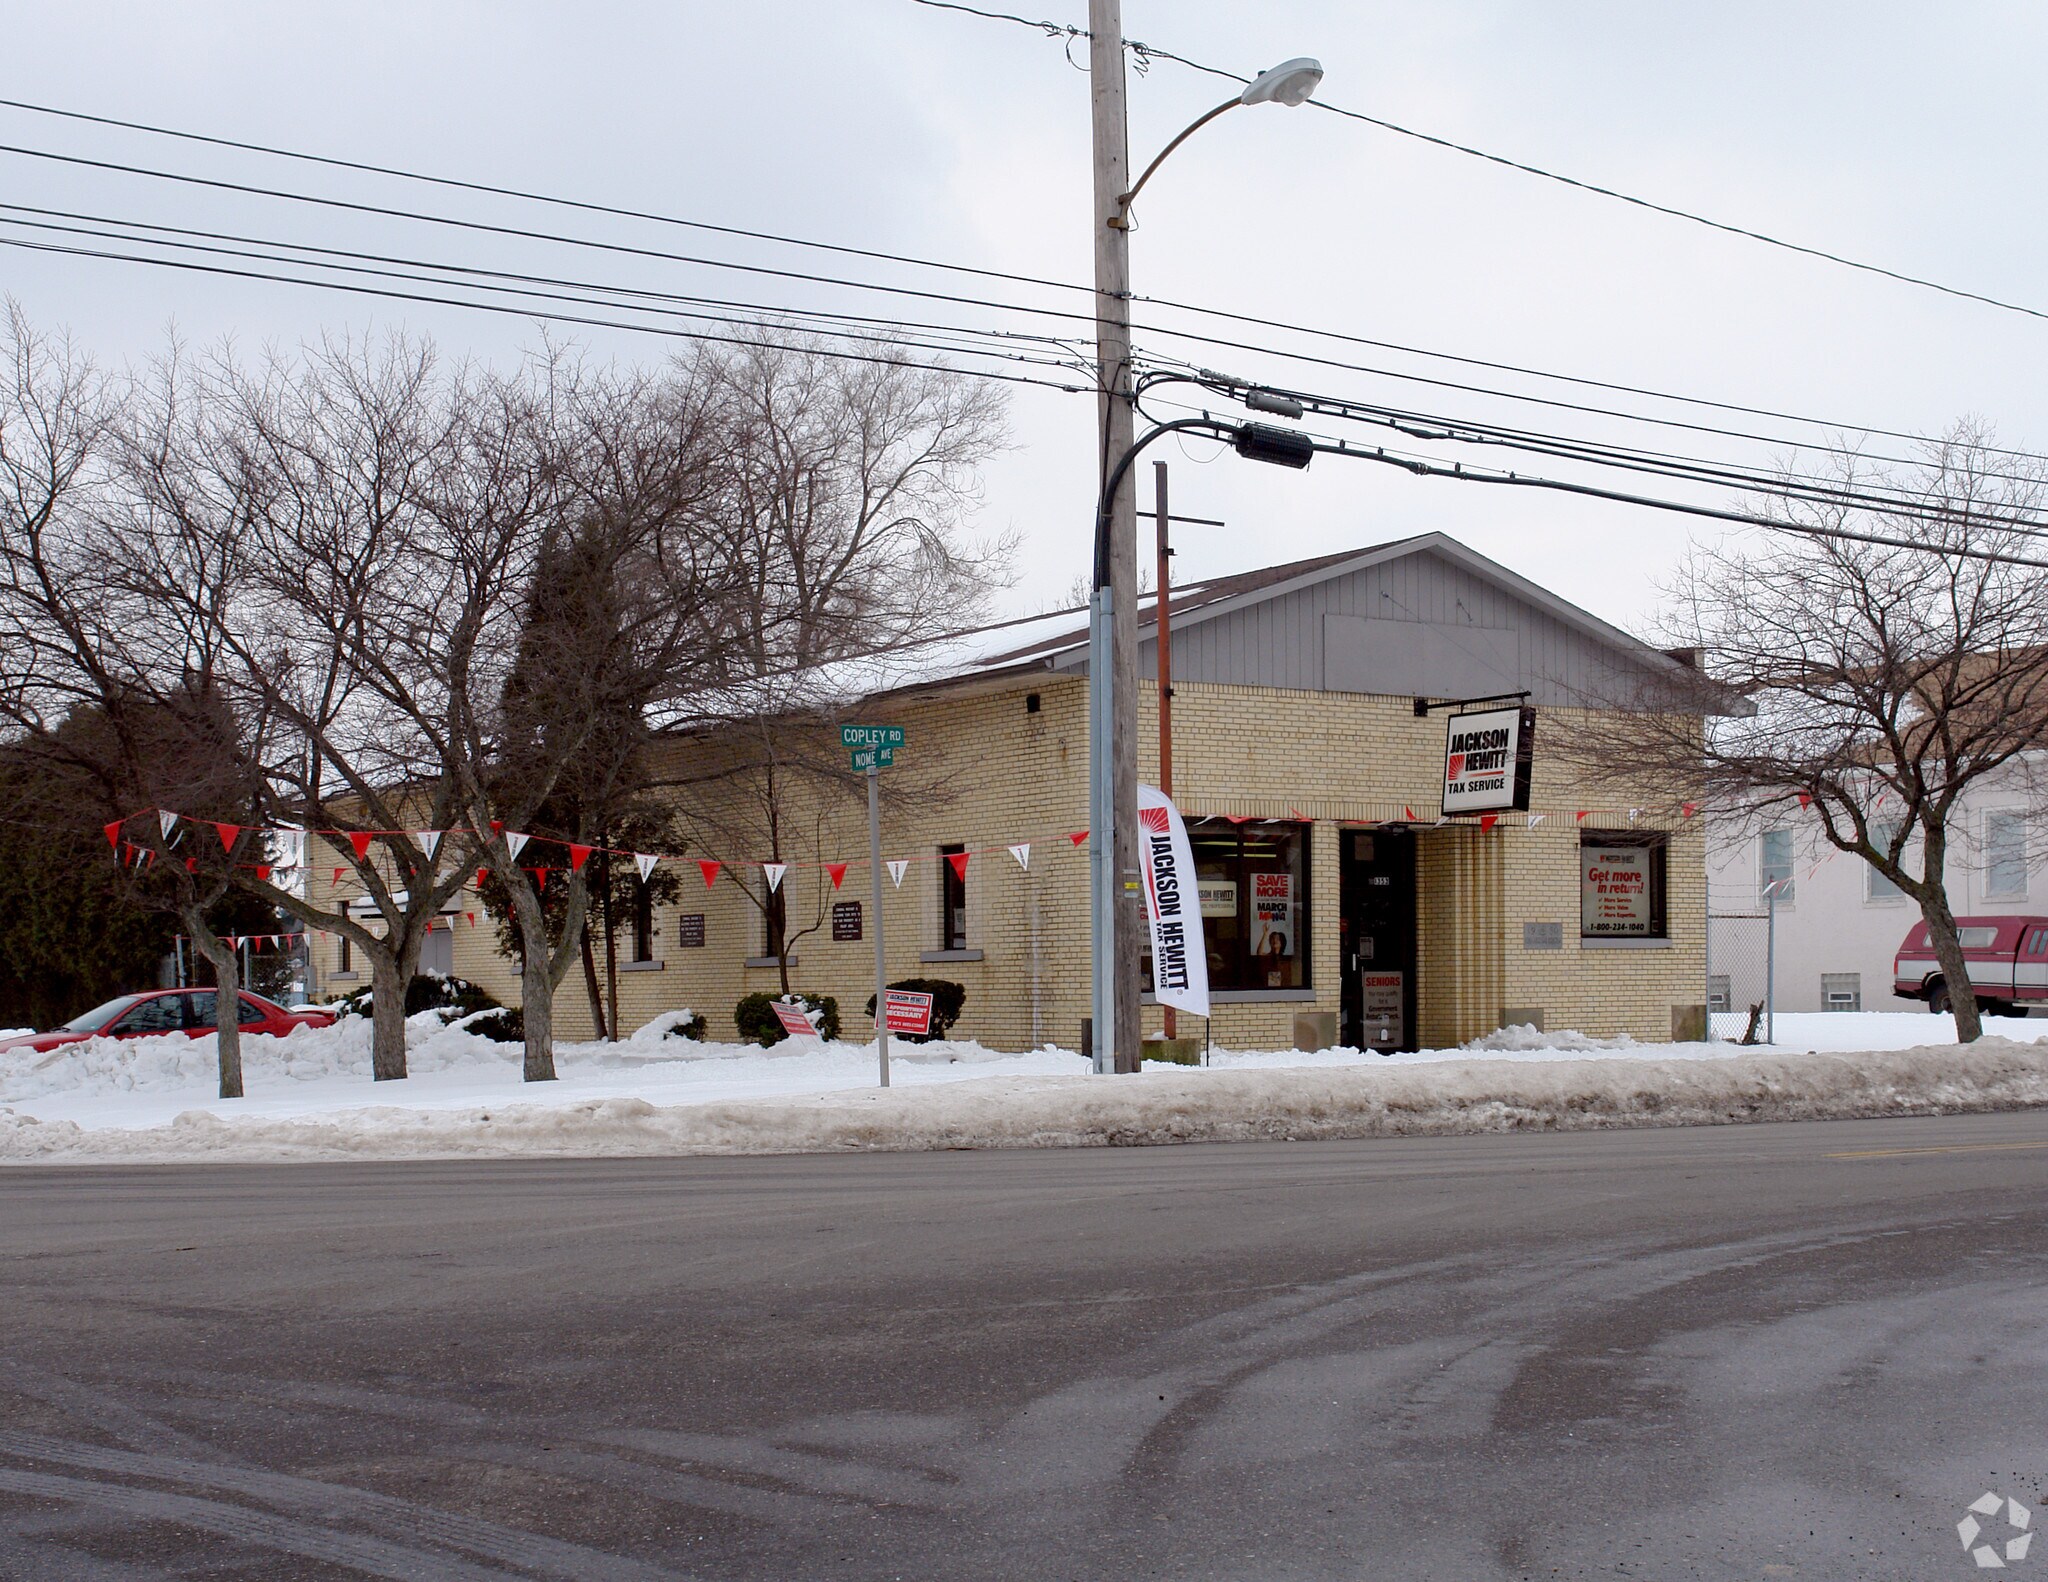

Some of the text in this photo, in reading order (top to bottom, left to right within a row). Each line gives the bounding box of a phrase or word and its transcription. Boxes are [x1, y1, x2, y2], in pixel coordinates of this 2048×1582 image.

[844, 728, 901, 743] COPLEY RD
[1450, 728, 1509, 753] JACKSON
[855, 748, 891, 767] NOME AVE
[1465, 749, 1507, 771] HEWITT
[1448, 778, 1505, 794] TAX SERVICE
[1256, 875, 1288, 886] SAVE
[1589, 867, 1642, 882] Get more
[1256, 887, 1288, 897] MORE
[1597, 881, 1644, 894] in return!
[1150, 836, 1189, 990] JACKSON HEWITT
[1257, 902, 1287, 911] MARCH
[1590, 923, 1645, 931] 1-800-234-1040
[1158, 946, 1168, 989] SERVICE
[1366, 977, 1400, 987] SENIORS
